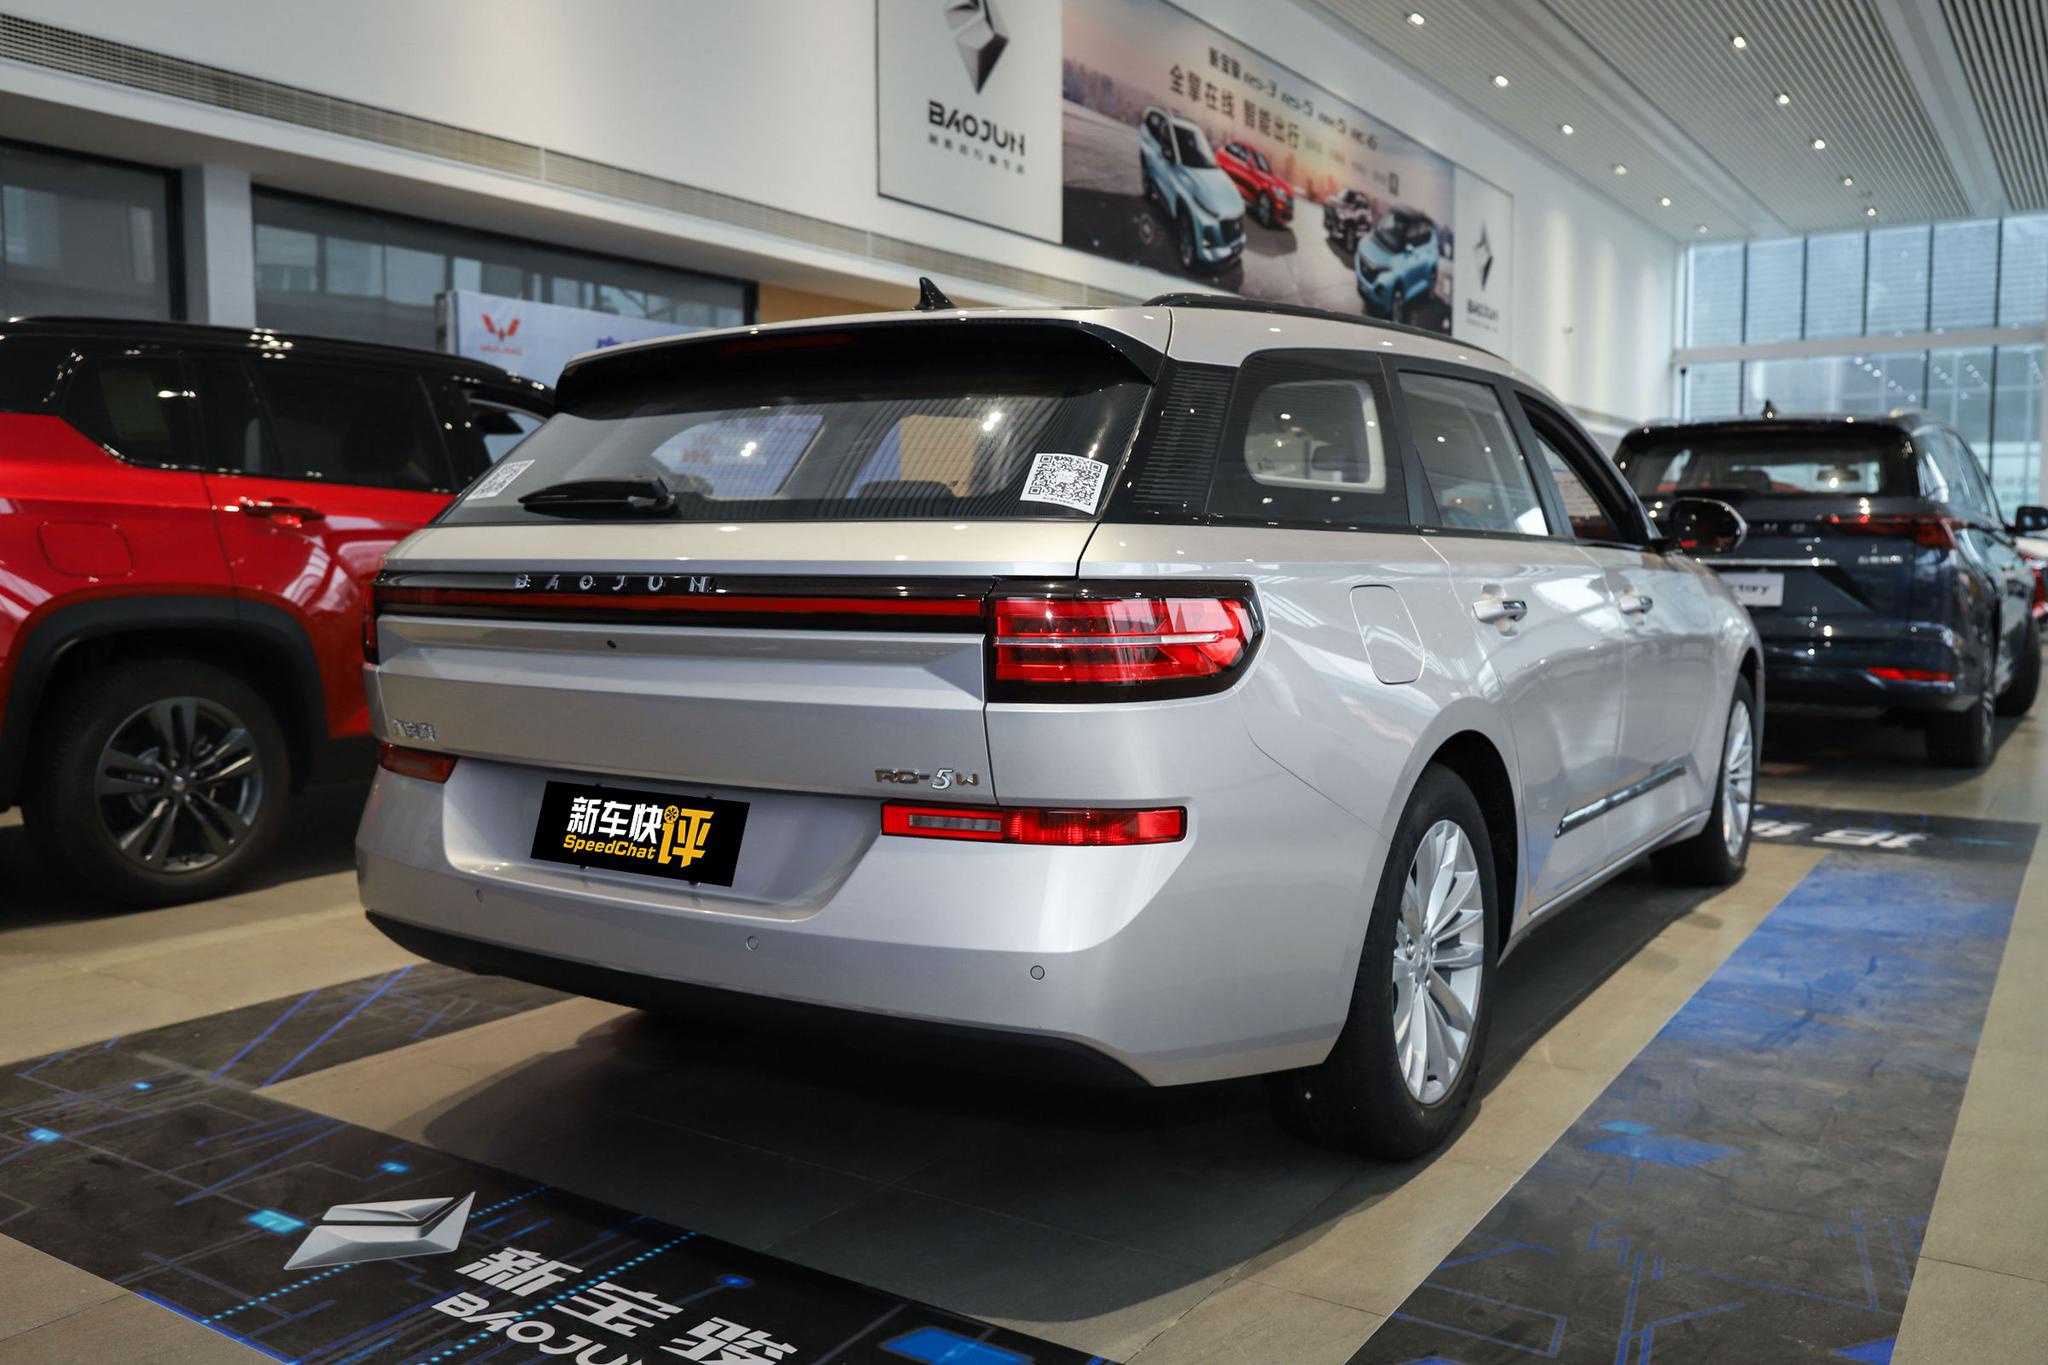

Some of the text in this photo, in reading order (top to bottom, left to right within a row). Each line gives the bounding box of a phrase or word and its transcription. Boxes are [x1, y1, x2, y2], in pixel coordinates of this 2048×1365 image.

[928, 99, 1025, 156] BAOJUN
[514, 573, 709, 593] BAOJUN
[431, 1291, 643, 1365] BAOJU
